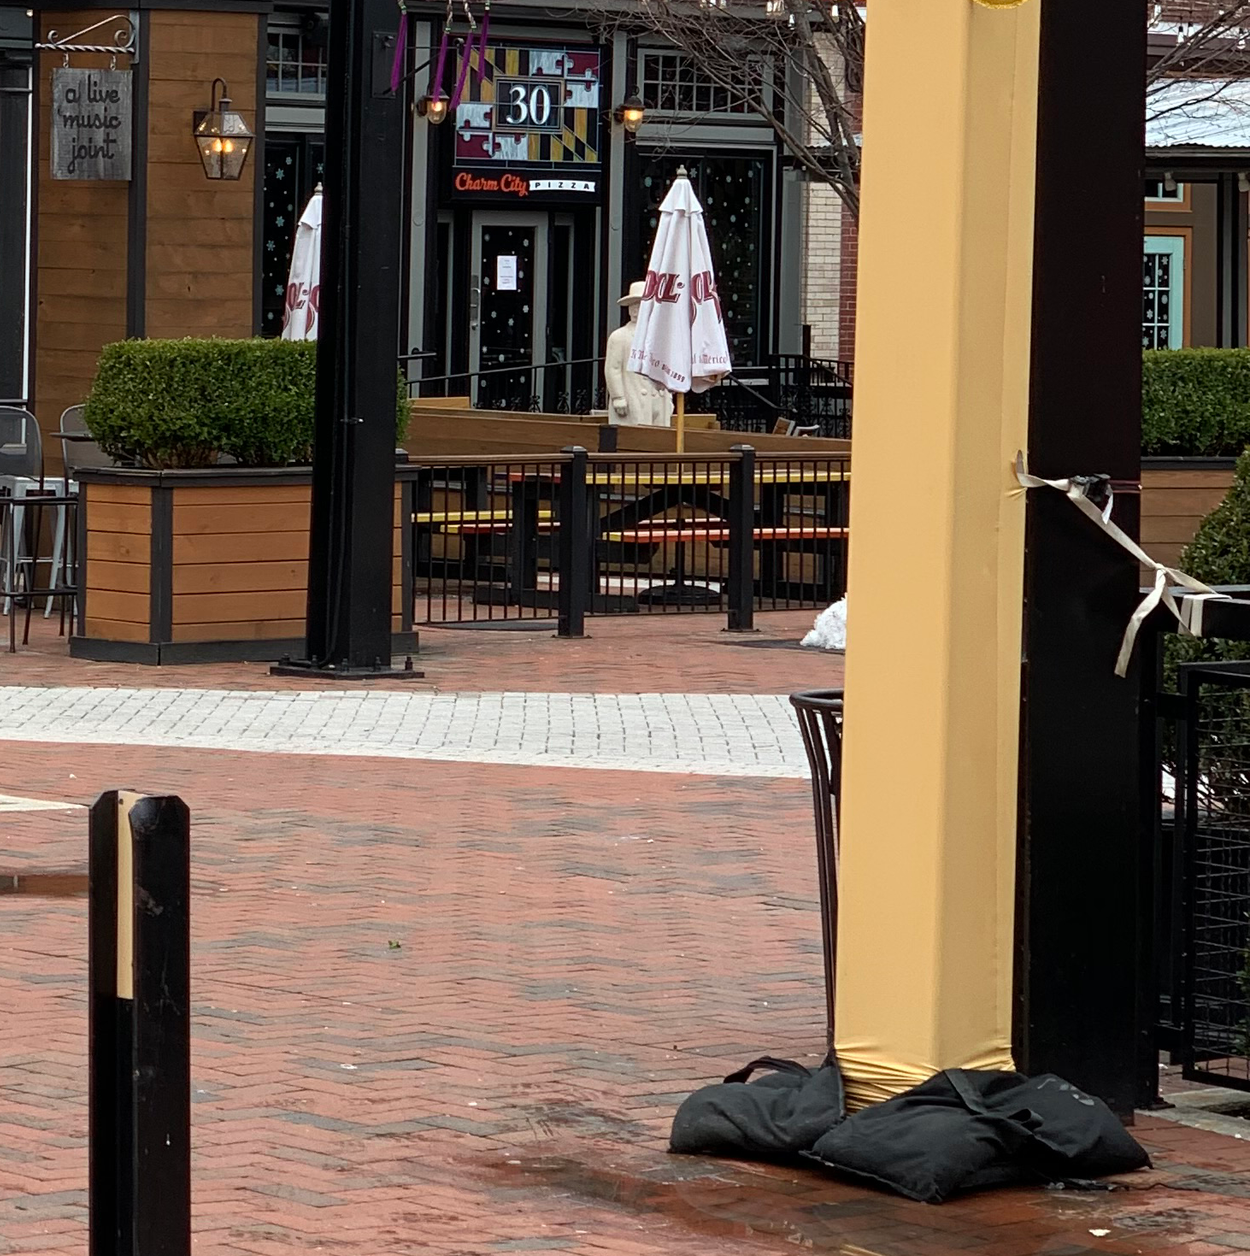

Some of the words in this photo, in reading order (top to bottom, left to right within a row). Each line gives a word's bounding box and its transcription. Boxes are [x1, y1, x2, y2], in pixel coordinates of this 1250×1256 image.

[64, 87, 80, 104] a
[87, 74, 121, 104] live
[61, 107, 122, 129] music
[505, 84, 551, 125] 30
[67, 133, 117, 174] joint
[455, 172, 499, 191] Charm
[500, 173, 528, 197] City
[534, 181, 590, 190] PIZZA
